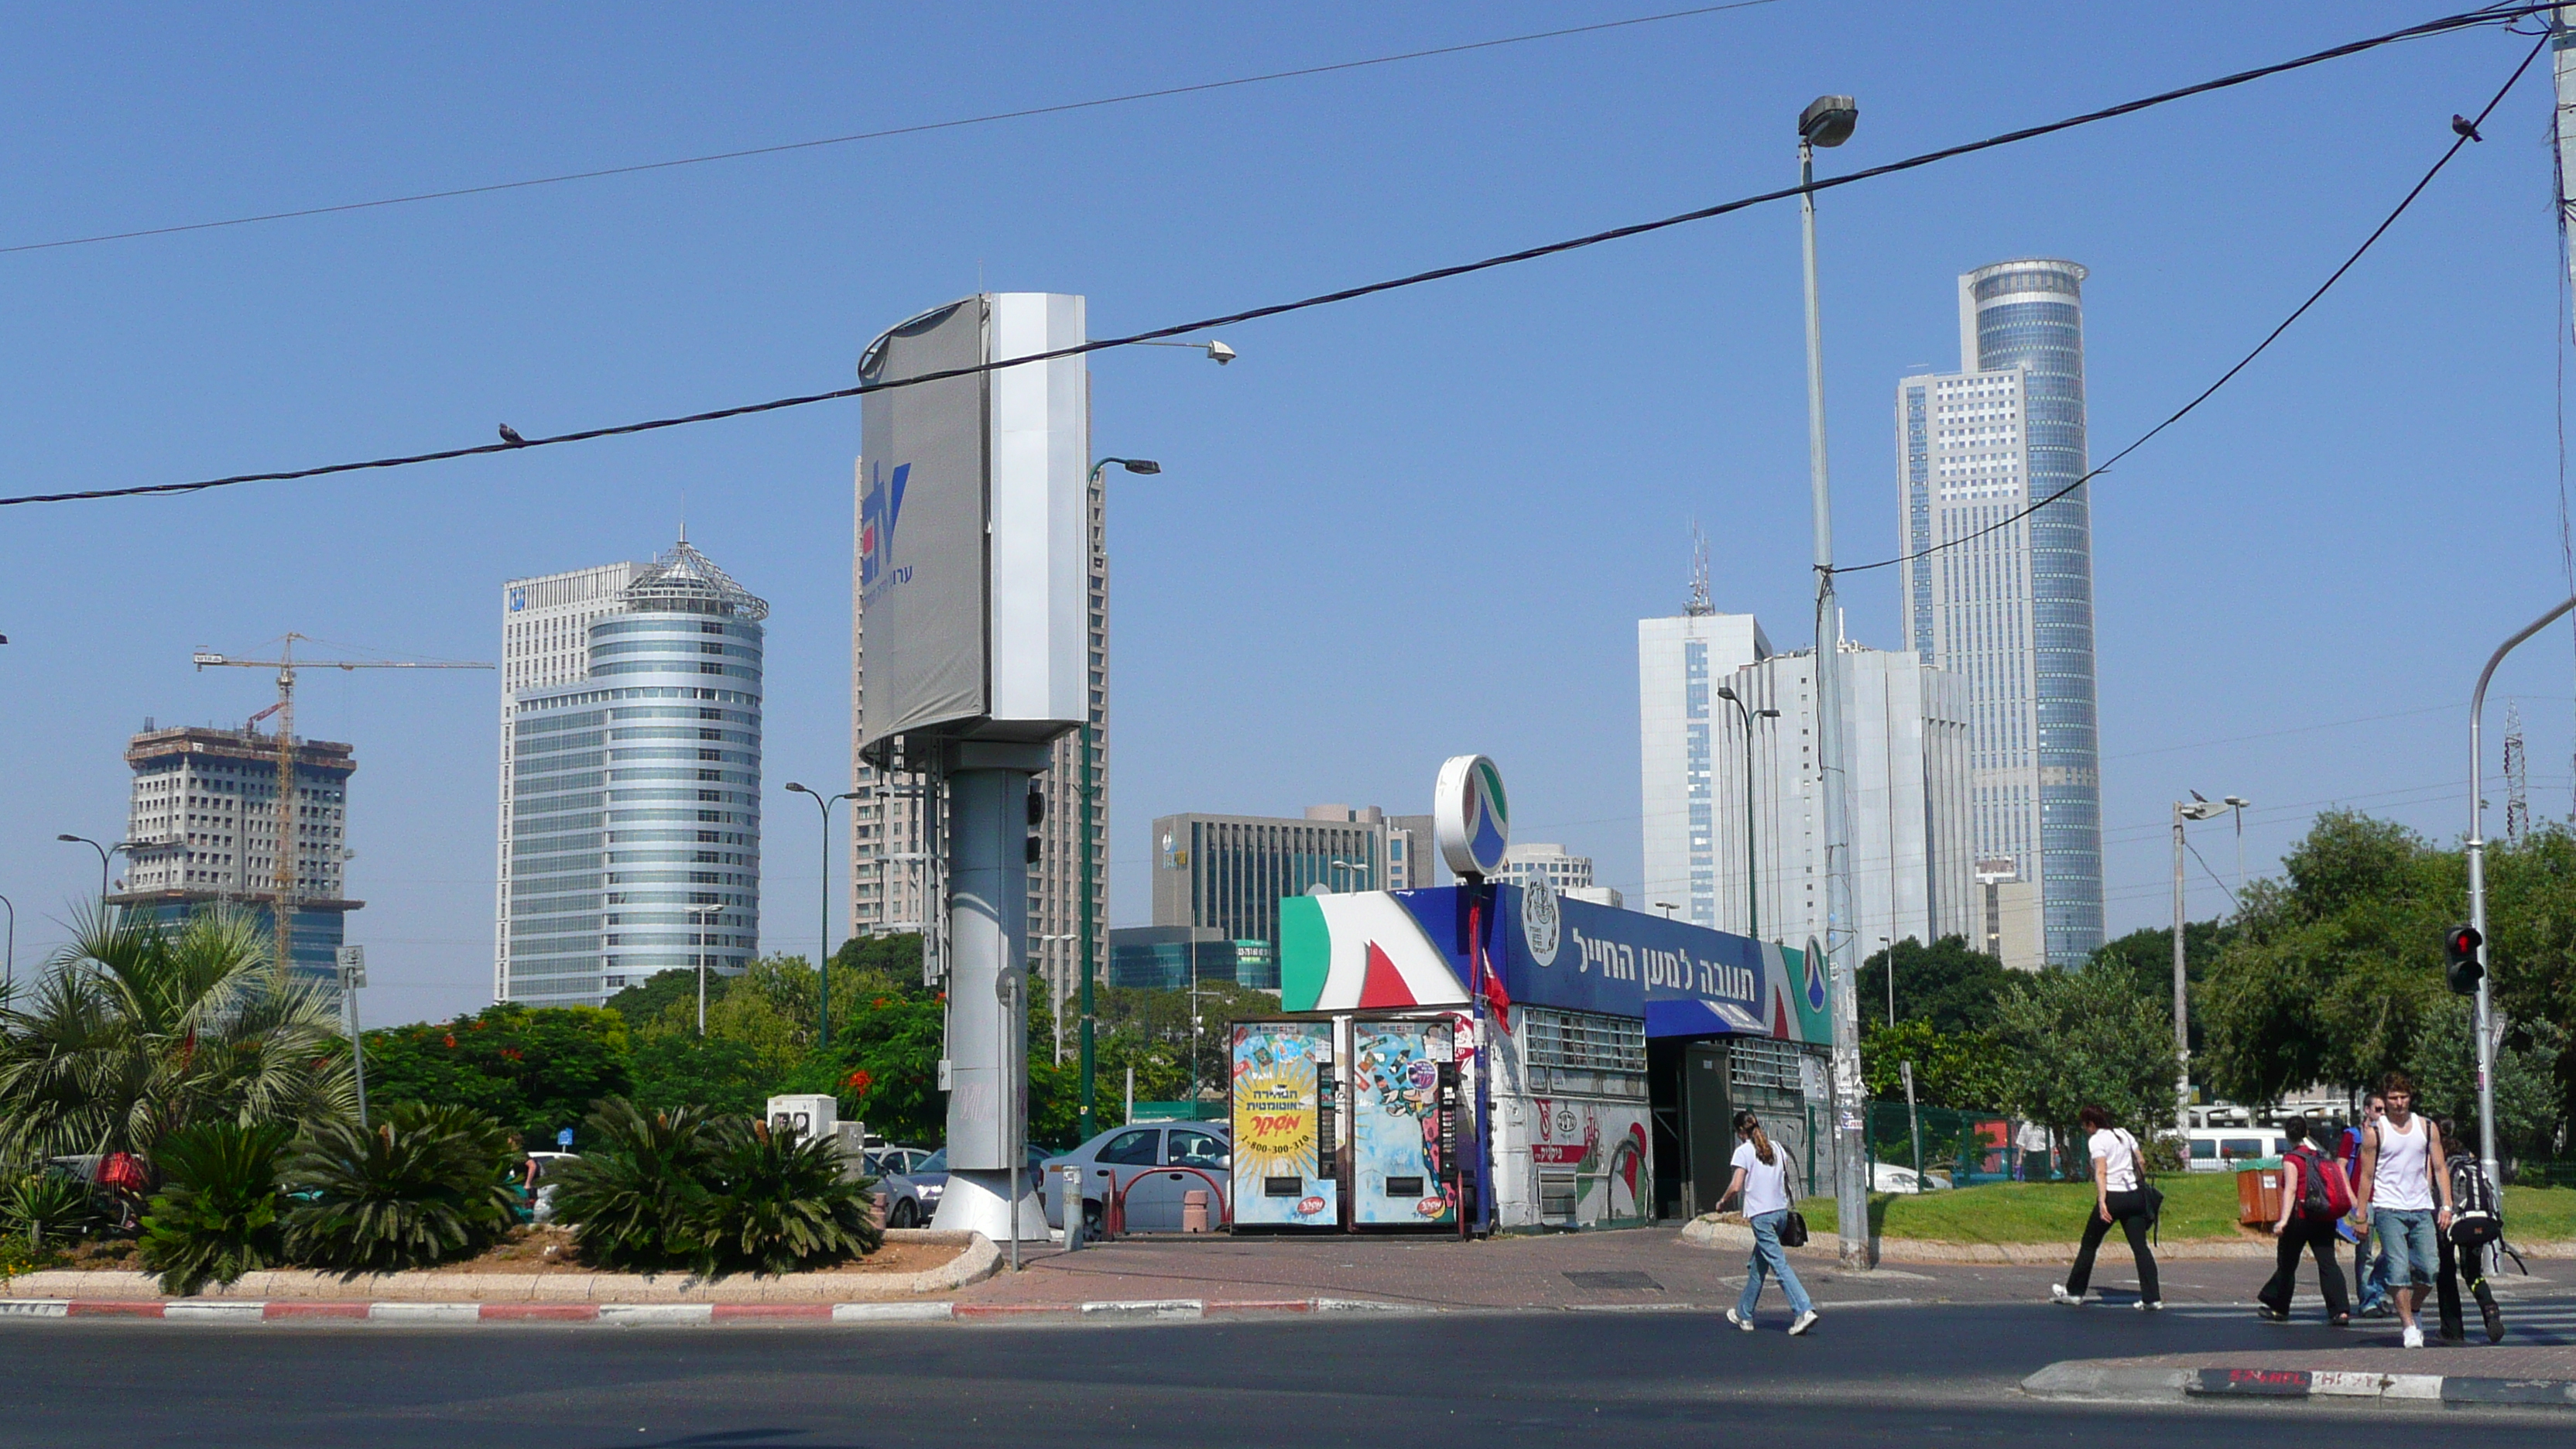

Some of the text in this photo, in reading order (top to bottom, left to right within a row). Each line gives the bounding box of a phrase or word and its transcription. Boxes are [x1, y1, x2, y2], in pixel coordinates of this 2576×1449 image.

[1572, 927, 1636, 981] החייל
[1642, 947, 1694, 992] למען
[1700, 959, 1756, 1002] תנובה
[1241, 1135, 1310, 1154] 1-800-300-310
